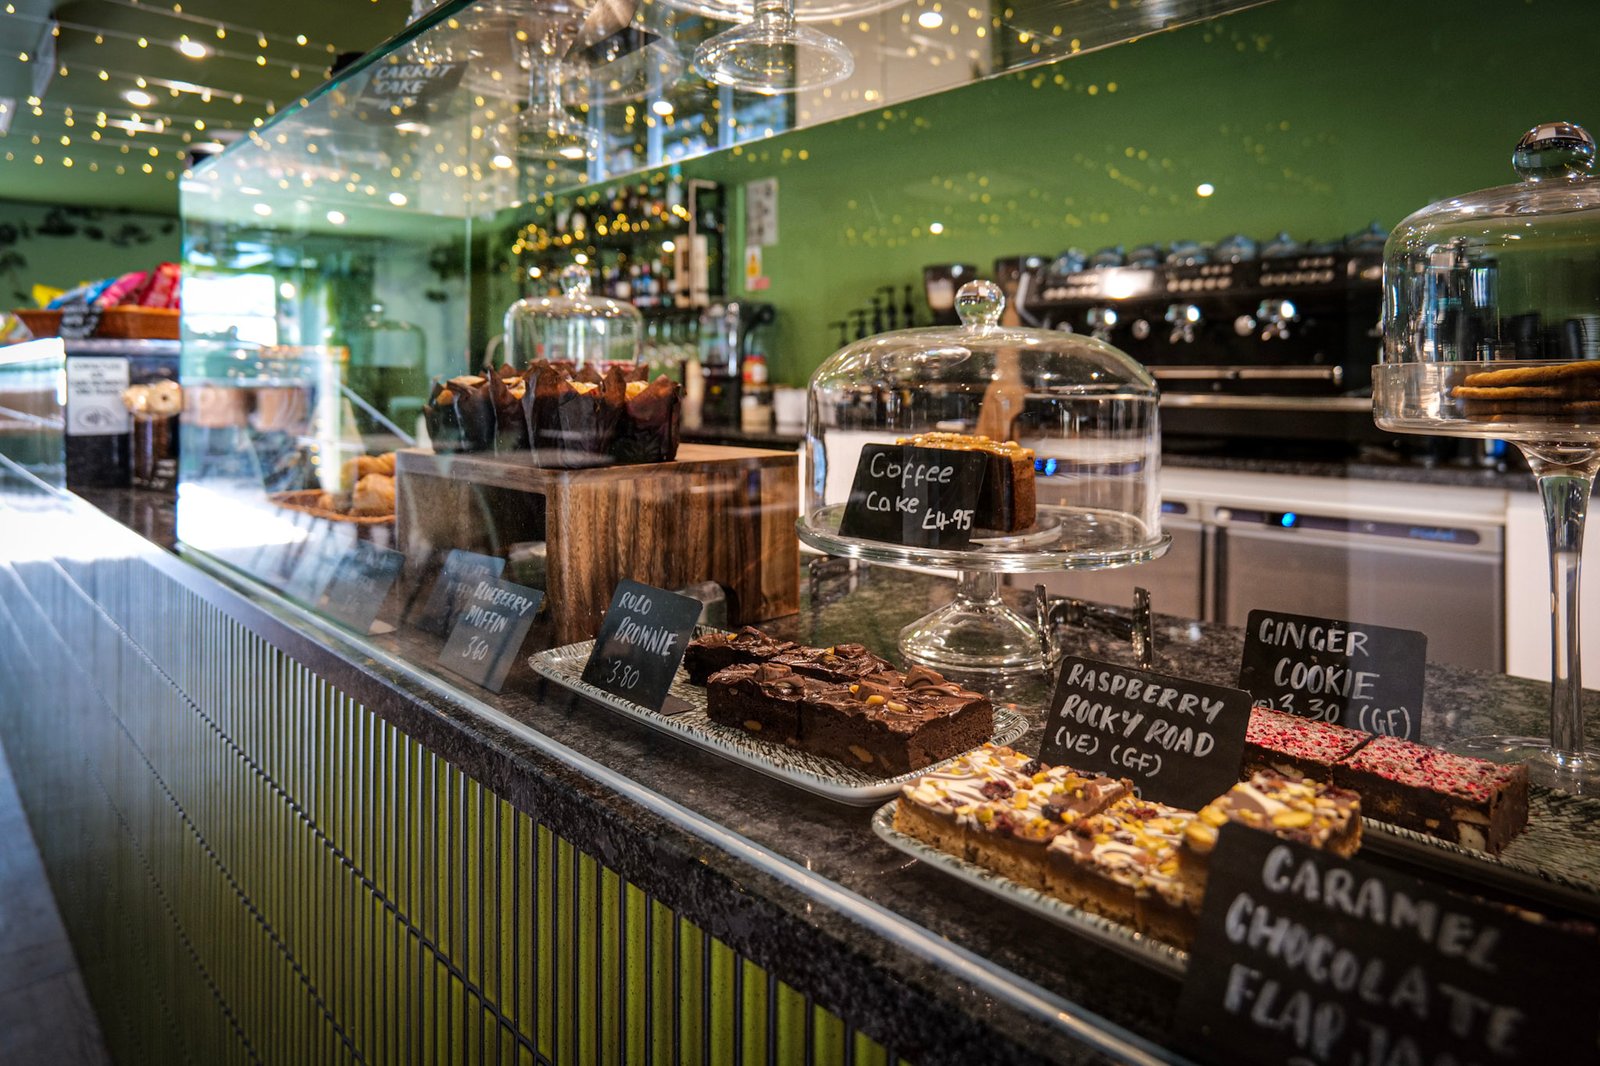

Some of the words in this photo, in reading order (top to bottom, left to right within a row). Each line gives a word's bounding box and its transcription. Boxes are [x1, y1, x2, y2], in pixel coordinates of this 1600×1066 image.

[374, 80, 428, 95] CAKE
[376, 64, 456, 80] CARROT
[870, 452, 954, 489] Coffee
[866, 491, 920, 514] Cake
[922, 508, 975, 531] £4.95
[473, 581, 534, 617] BLUEBERRY
[618, 591, 652, 616] ROLO
[465, 604, 510, 634] MUFFIN
[613, 616, 679, 657] BROWNIE
[1258, 617, 1370, 657] GINGER
[1066, 663, 1225, 725] RASPBERRY
[1274, 657, 1381, 700] COOKIE
[1059, 694, 1145, 739] ROCKY
[1144, 718, 1215, 758] ROAD
[1358, 704, 1412, 741] (GF)
[1055, 726, 1100, 756] (VE)
[1109, 744, 1162, 778] (GF)
[1261, 844, 1502, 974] CARAMEL
[1224, 892, 1526, 1058] CHOCOLATE
[1222, 962, 1484, 1066] FLAPJA
